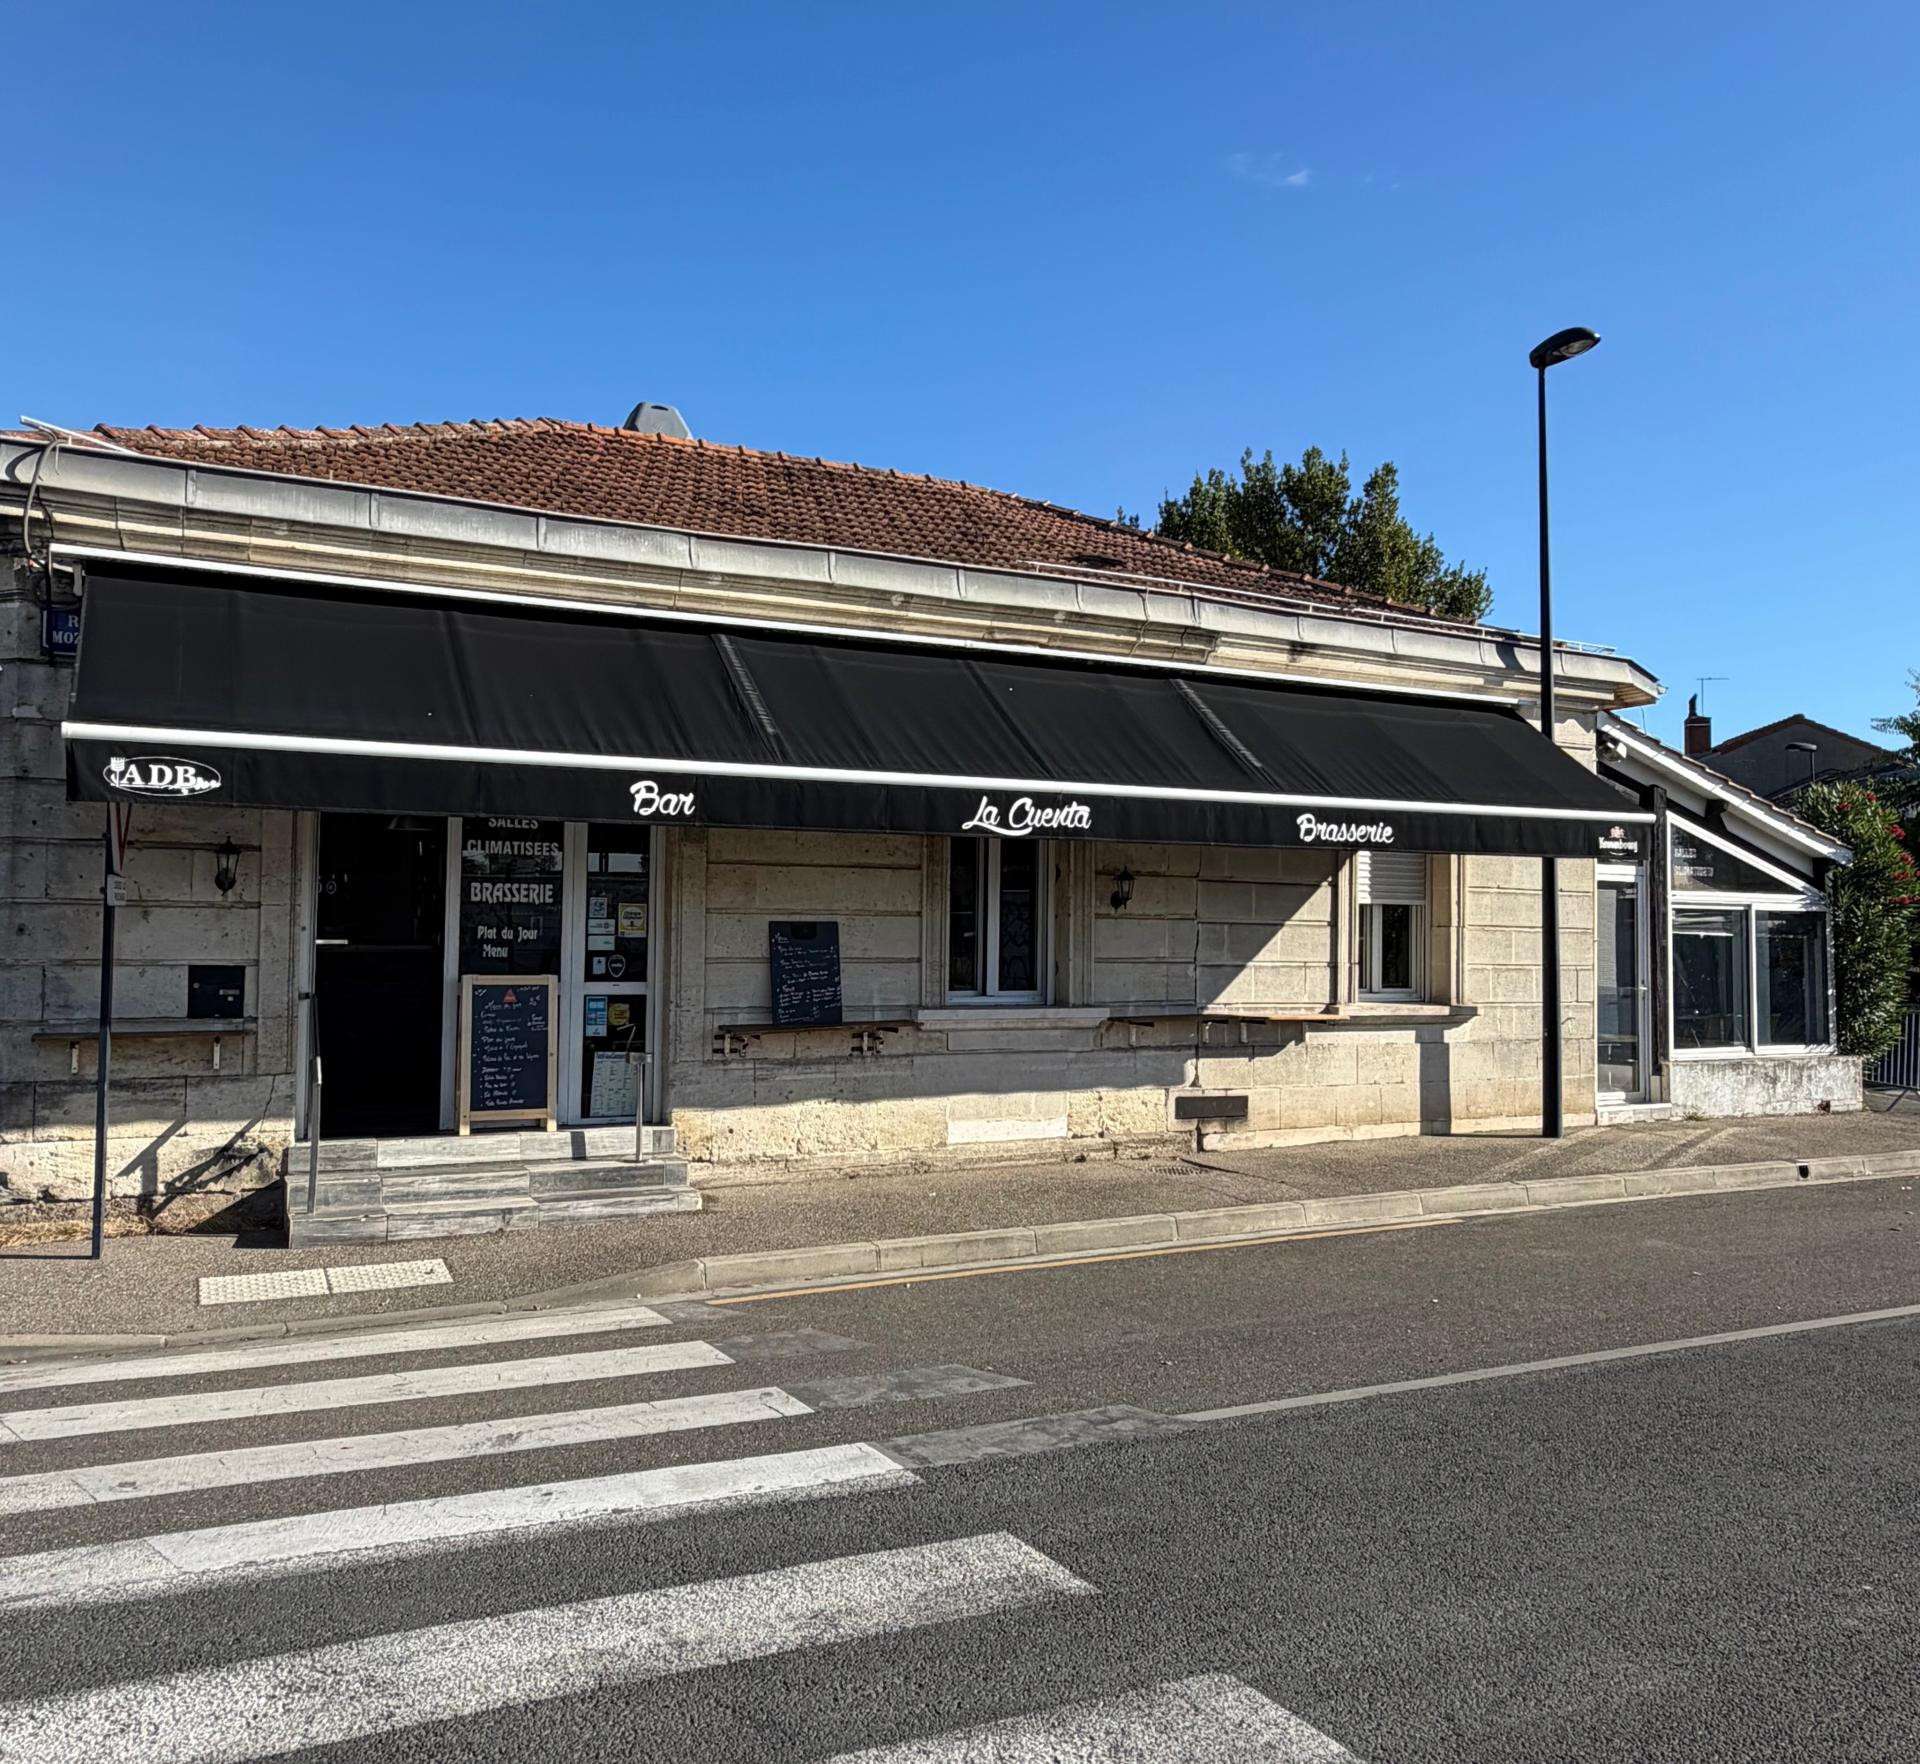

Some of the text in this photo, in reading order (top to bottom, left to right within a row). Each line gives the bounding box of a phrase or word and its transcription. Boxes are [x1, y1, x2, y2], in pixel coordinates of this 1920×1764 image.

[120, 763, 197, 788] ADB
[629, 780, 697, 816] Bar
[488, 817, 539, 830] SALLES
[961, 795, 1093, 837] La Cuenta
[1296, 813, 1396, 844] Brasserie
[466, 839, 561, 857] CLIMATISEES
[470, 882, 554, 905] BRASSERIE
[477, 925, 497, 940] Plat
[501, 927, 514, 940] du
[482, 943, 509, 958] Menu
